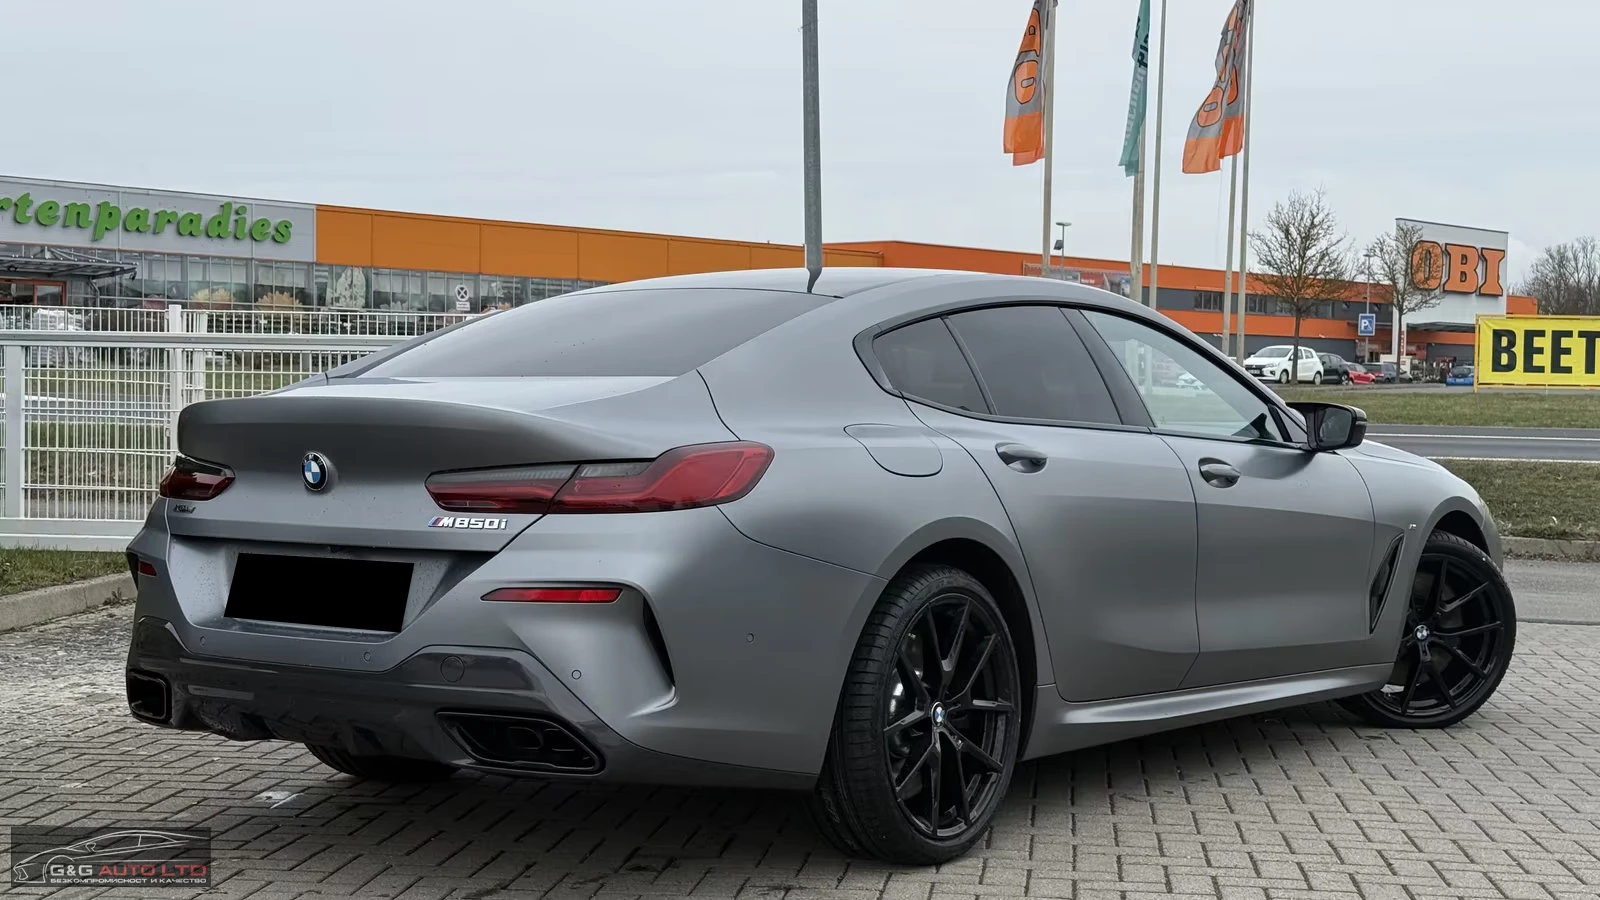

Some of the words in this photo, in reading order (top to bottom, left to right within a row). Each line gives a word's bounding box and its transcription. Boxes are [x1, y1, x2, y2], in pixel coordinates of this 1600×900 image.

[1411, 240, 1505, 297] OBI
[1491, 328, 1600, 375] BEET
[438, 516, 508, 530] M850i
